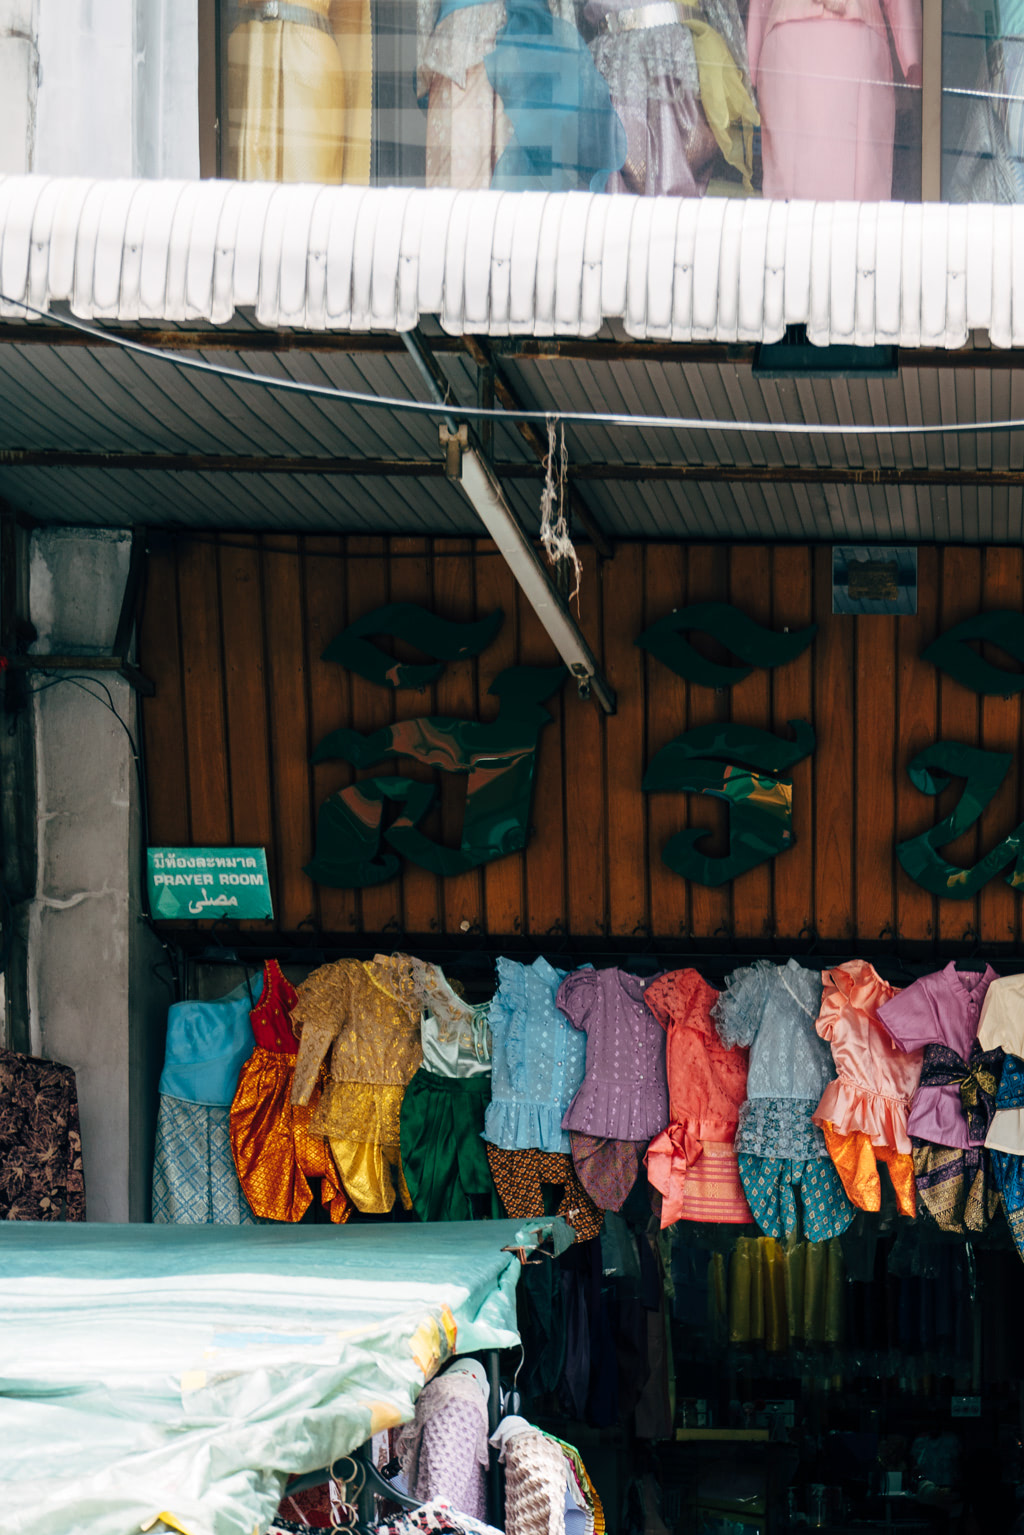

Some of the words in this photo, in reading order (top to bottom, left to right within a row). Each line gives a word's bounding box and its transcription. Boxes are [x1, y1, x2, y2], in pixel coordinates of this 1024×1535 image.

[153, 852, 257, 868] มีห้องละหมาด
[153, 874, 214, 886] PRAYER
[219, 874, 264, 885] ROOM
